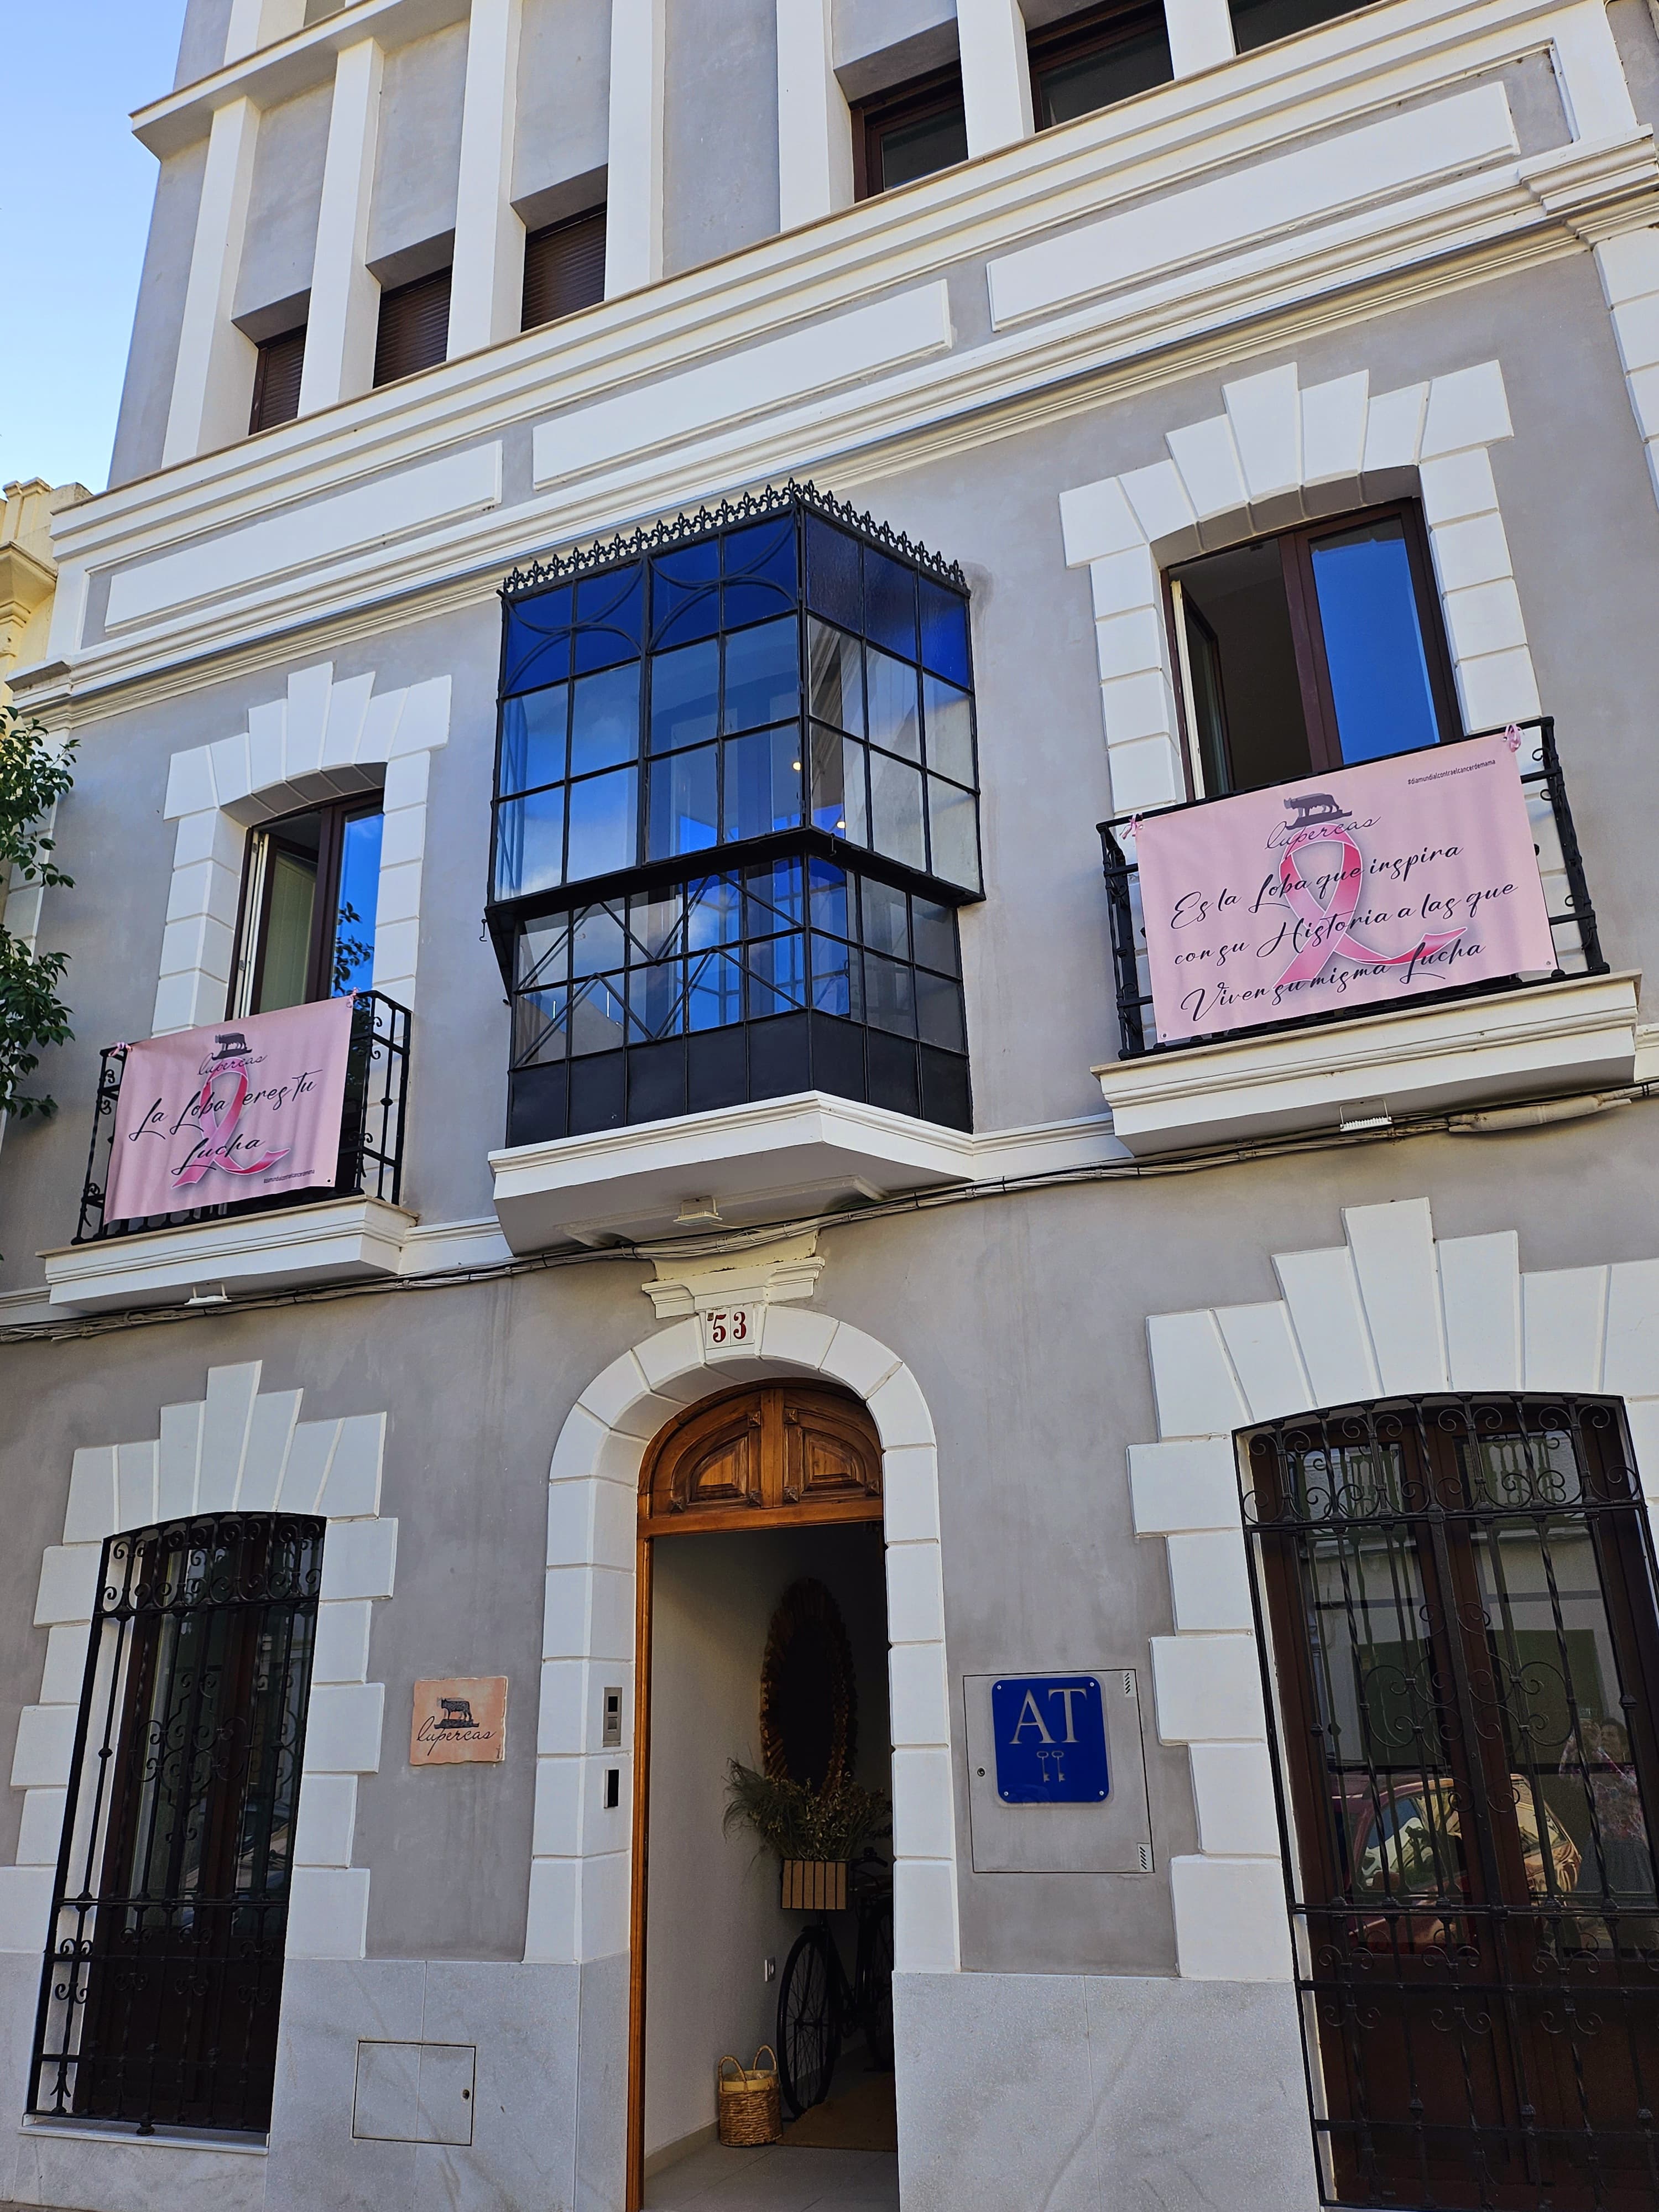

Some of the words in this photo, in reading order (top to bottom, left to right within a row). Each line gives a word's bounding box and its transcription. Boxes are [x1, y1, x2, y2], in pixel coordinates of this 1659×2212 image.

[1264, 816, 1381, 860] lupercas
[1171, 891, 1214, 930] Es
[1218, 888, 1242, 911] la
[1248, 874, 1313, 914] Loba
[1316, 867, 1365, 900] que
[1369, 846, 1464, 881] inspira
[1175, 950, 1215, 965] con
[1216, 941, 1250, 967] su
[1256, 909, 1393, 958] Historia
[1397, 907, 1417, 918] a
[1421, 893, 1462, 920] las
[1466, 883, 1519, 918] que
[1180, 982, 1271, 1022] Viven
[1271, 980, 1308, 1006] su
[1310, 965, 1393, 993] misma
[1400, 938, 1486, 984] Lucha
[128, 1098, 168, 1141] La
[170, 1091, 229, 1135] Loba
[242, 1086, 293, 1110] eres
[171, 1134, 266, 1176] Lucha
[712, 1311, 747, 1343] 53
[416, 1715, 497, 1756] lupercas
[1008, 1687, 1088, 1745] AT
